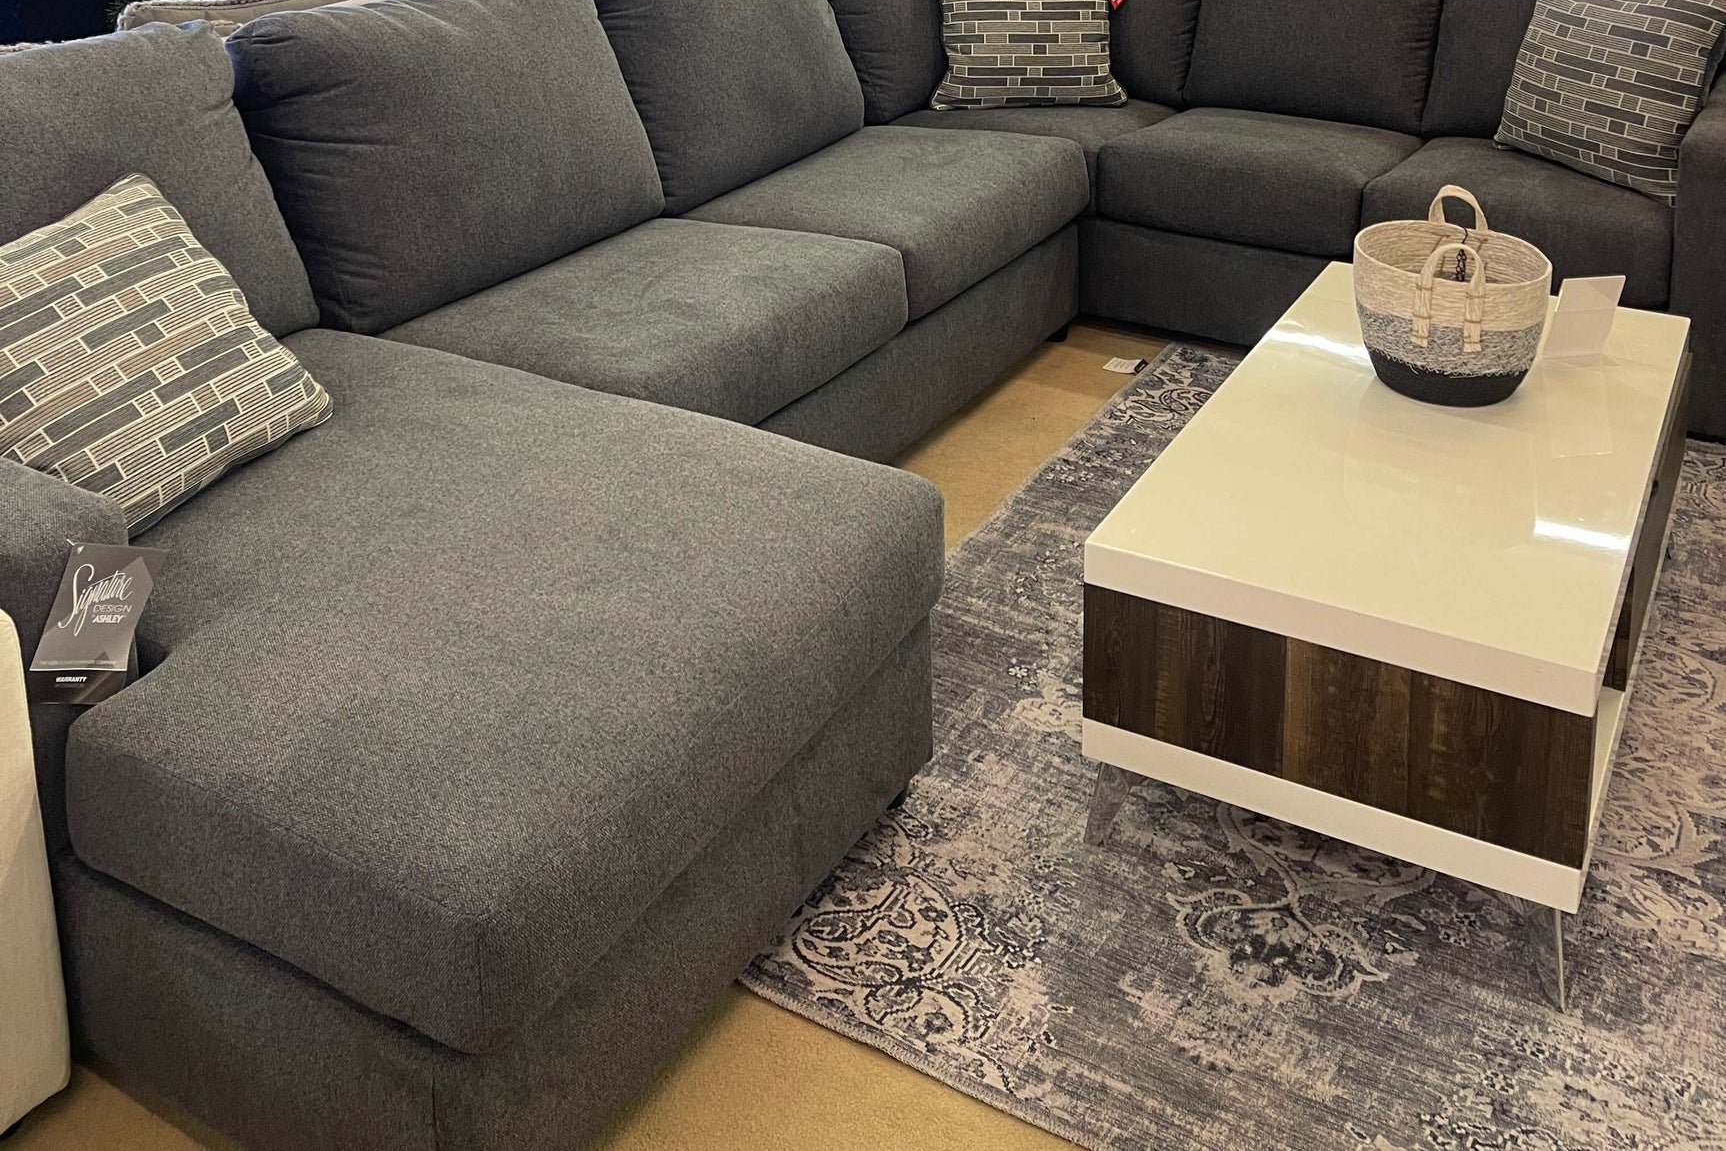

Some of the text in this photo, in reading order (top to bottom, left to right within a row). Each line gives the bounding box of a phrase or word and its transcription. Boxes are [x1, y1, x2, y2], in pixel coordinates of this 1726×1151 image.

[57, 563, 134, 637] Signature
[93, 604, 133, 614] DESIGN
[92, 614, 125, 624] ASHLEY
